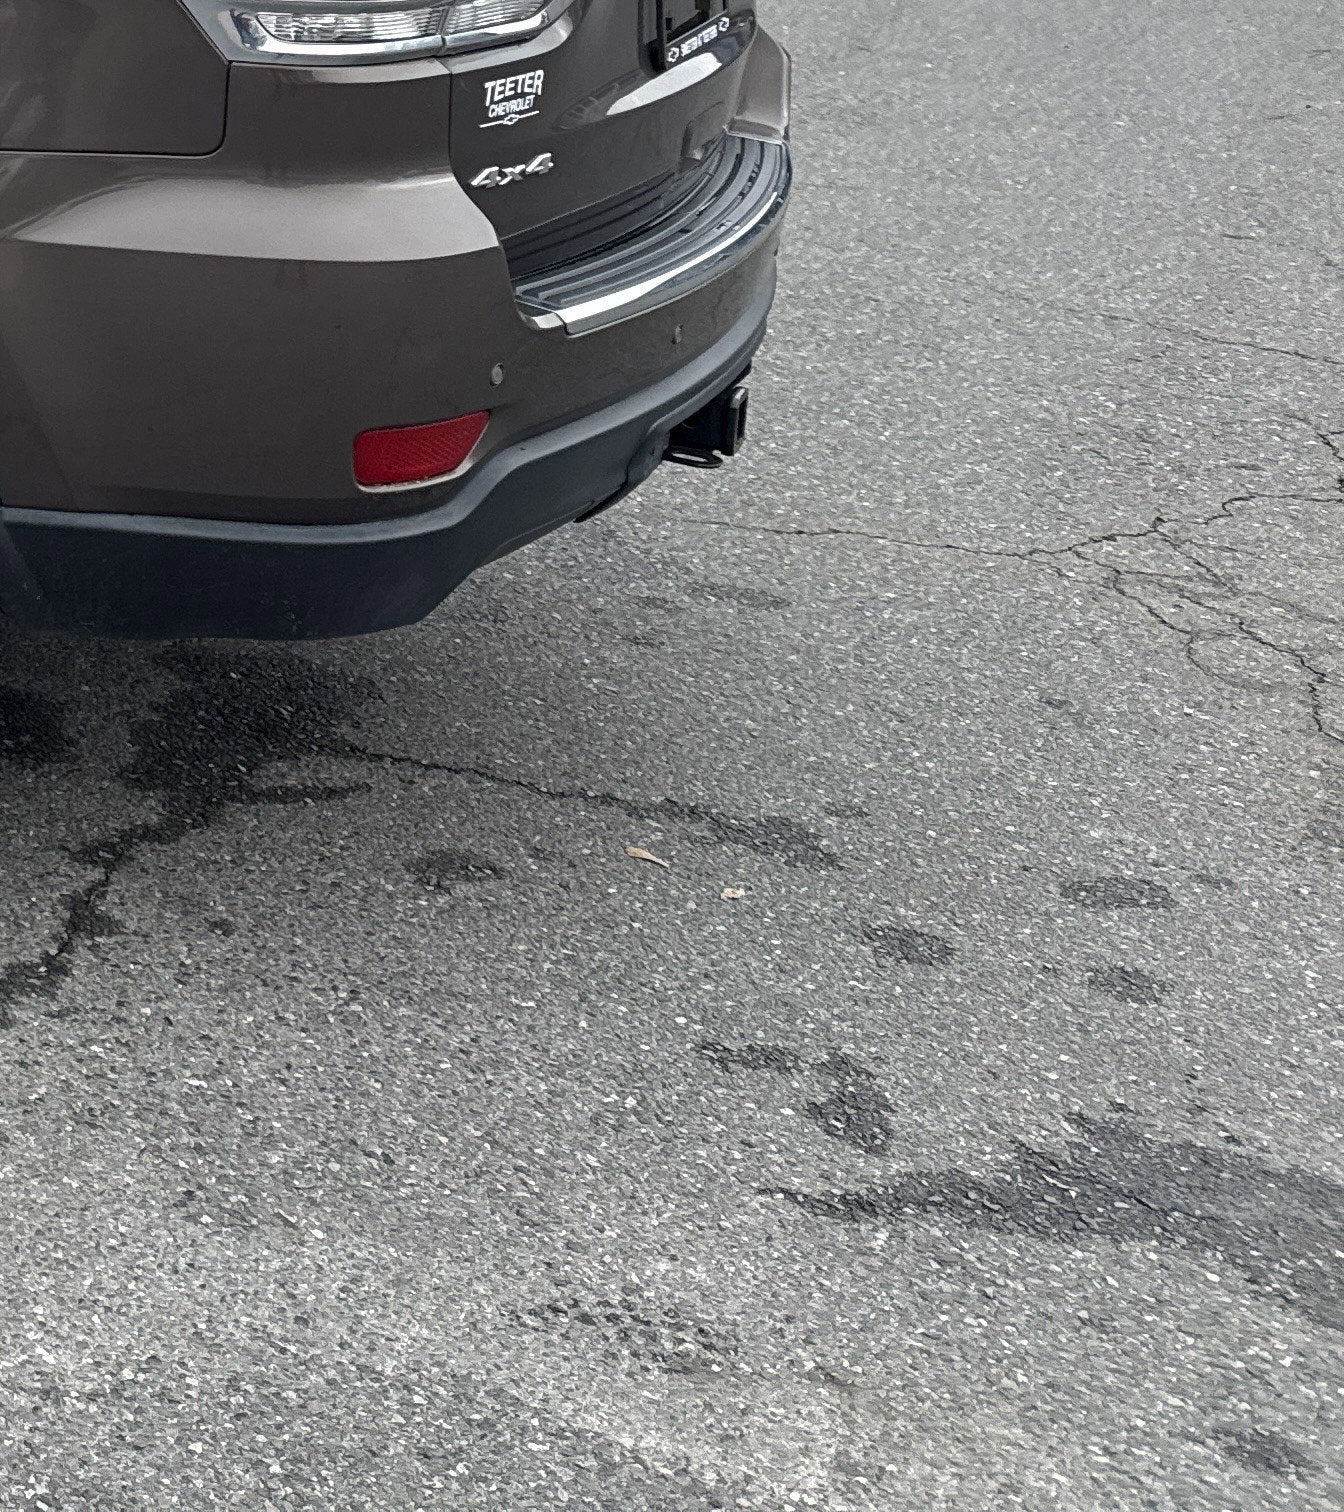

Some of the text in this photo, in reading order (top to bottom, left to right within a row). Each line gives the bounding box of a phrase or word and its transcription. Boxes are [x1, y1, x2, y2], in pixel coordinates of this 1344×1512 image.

[484, 69, 544, 106] TEETER
[488, 94, 535, 117] CHEVROLET
[469, 152, 554, 189] 4x4
